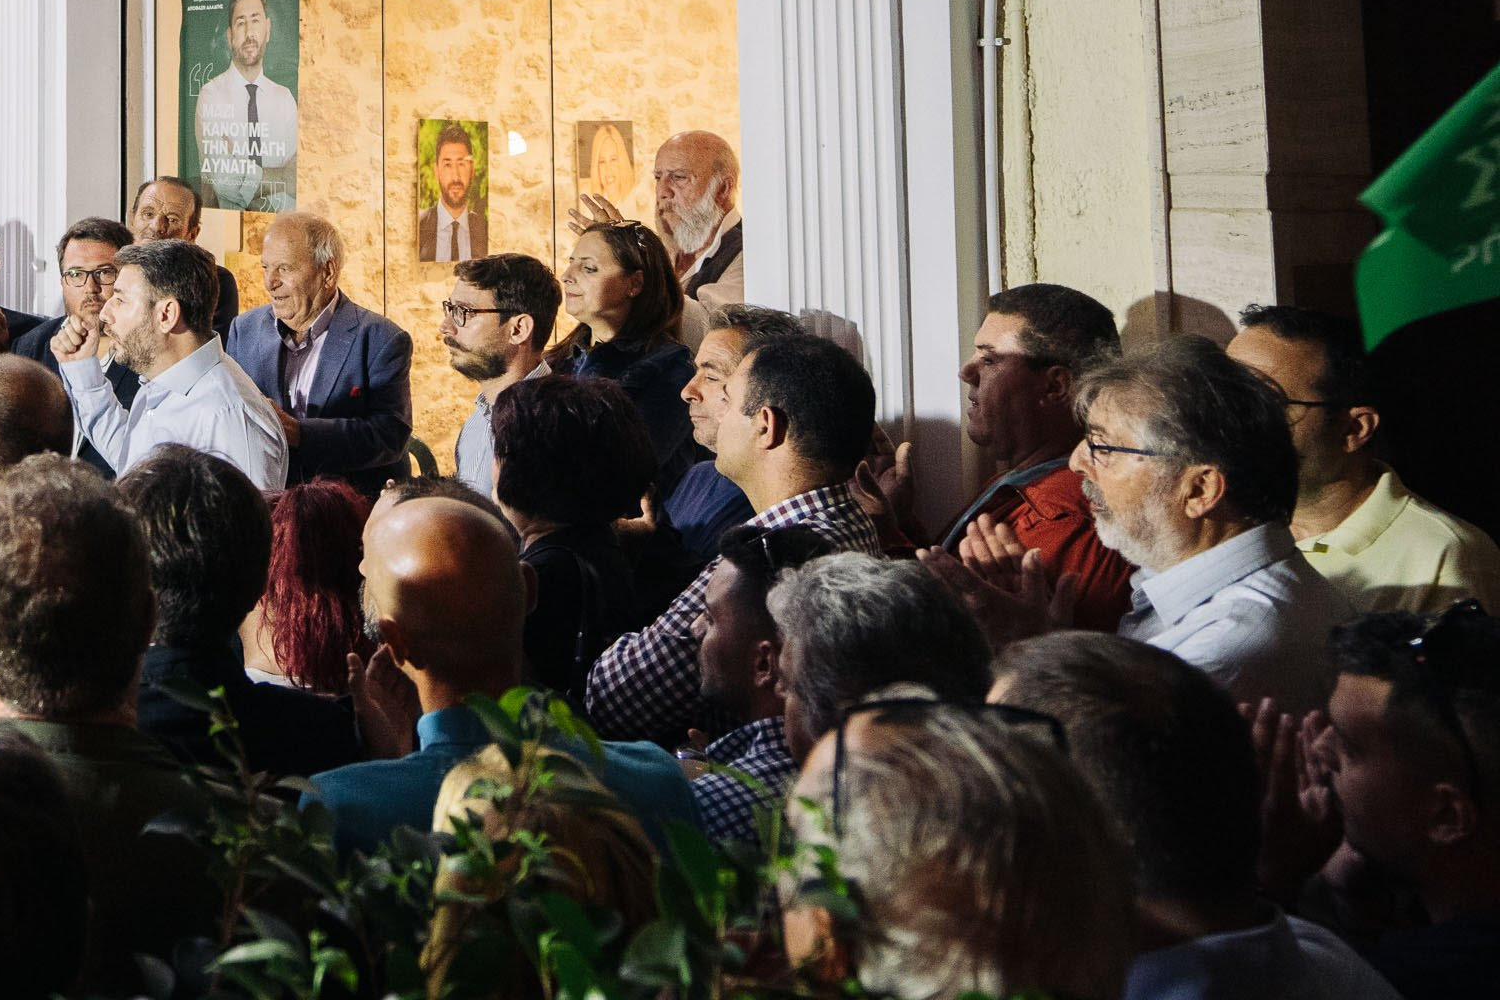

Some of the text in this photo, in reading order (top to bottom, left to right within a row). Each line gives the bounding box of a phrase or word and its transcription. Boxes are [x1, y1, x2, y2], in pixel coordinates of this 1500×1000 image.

[202, 121, 269, 138] ΚΑΝΟΥΜΕ
[201, 139, 286, 157] ΤΗΝ ΑΛΛΑΓΗ
[200, 158, 257, 175] ΔΥΝΑΤΗ
